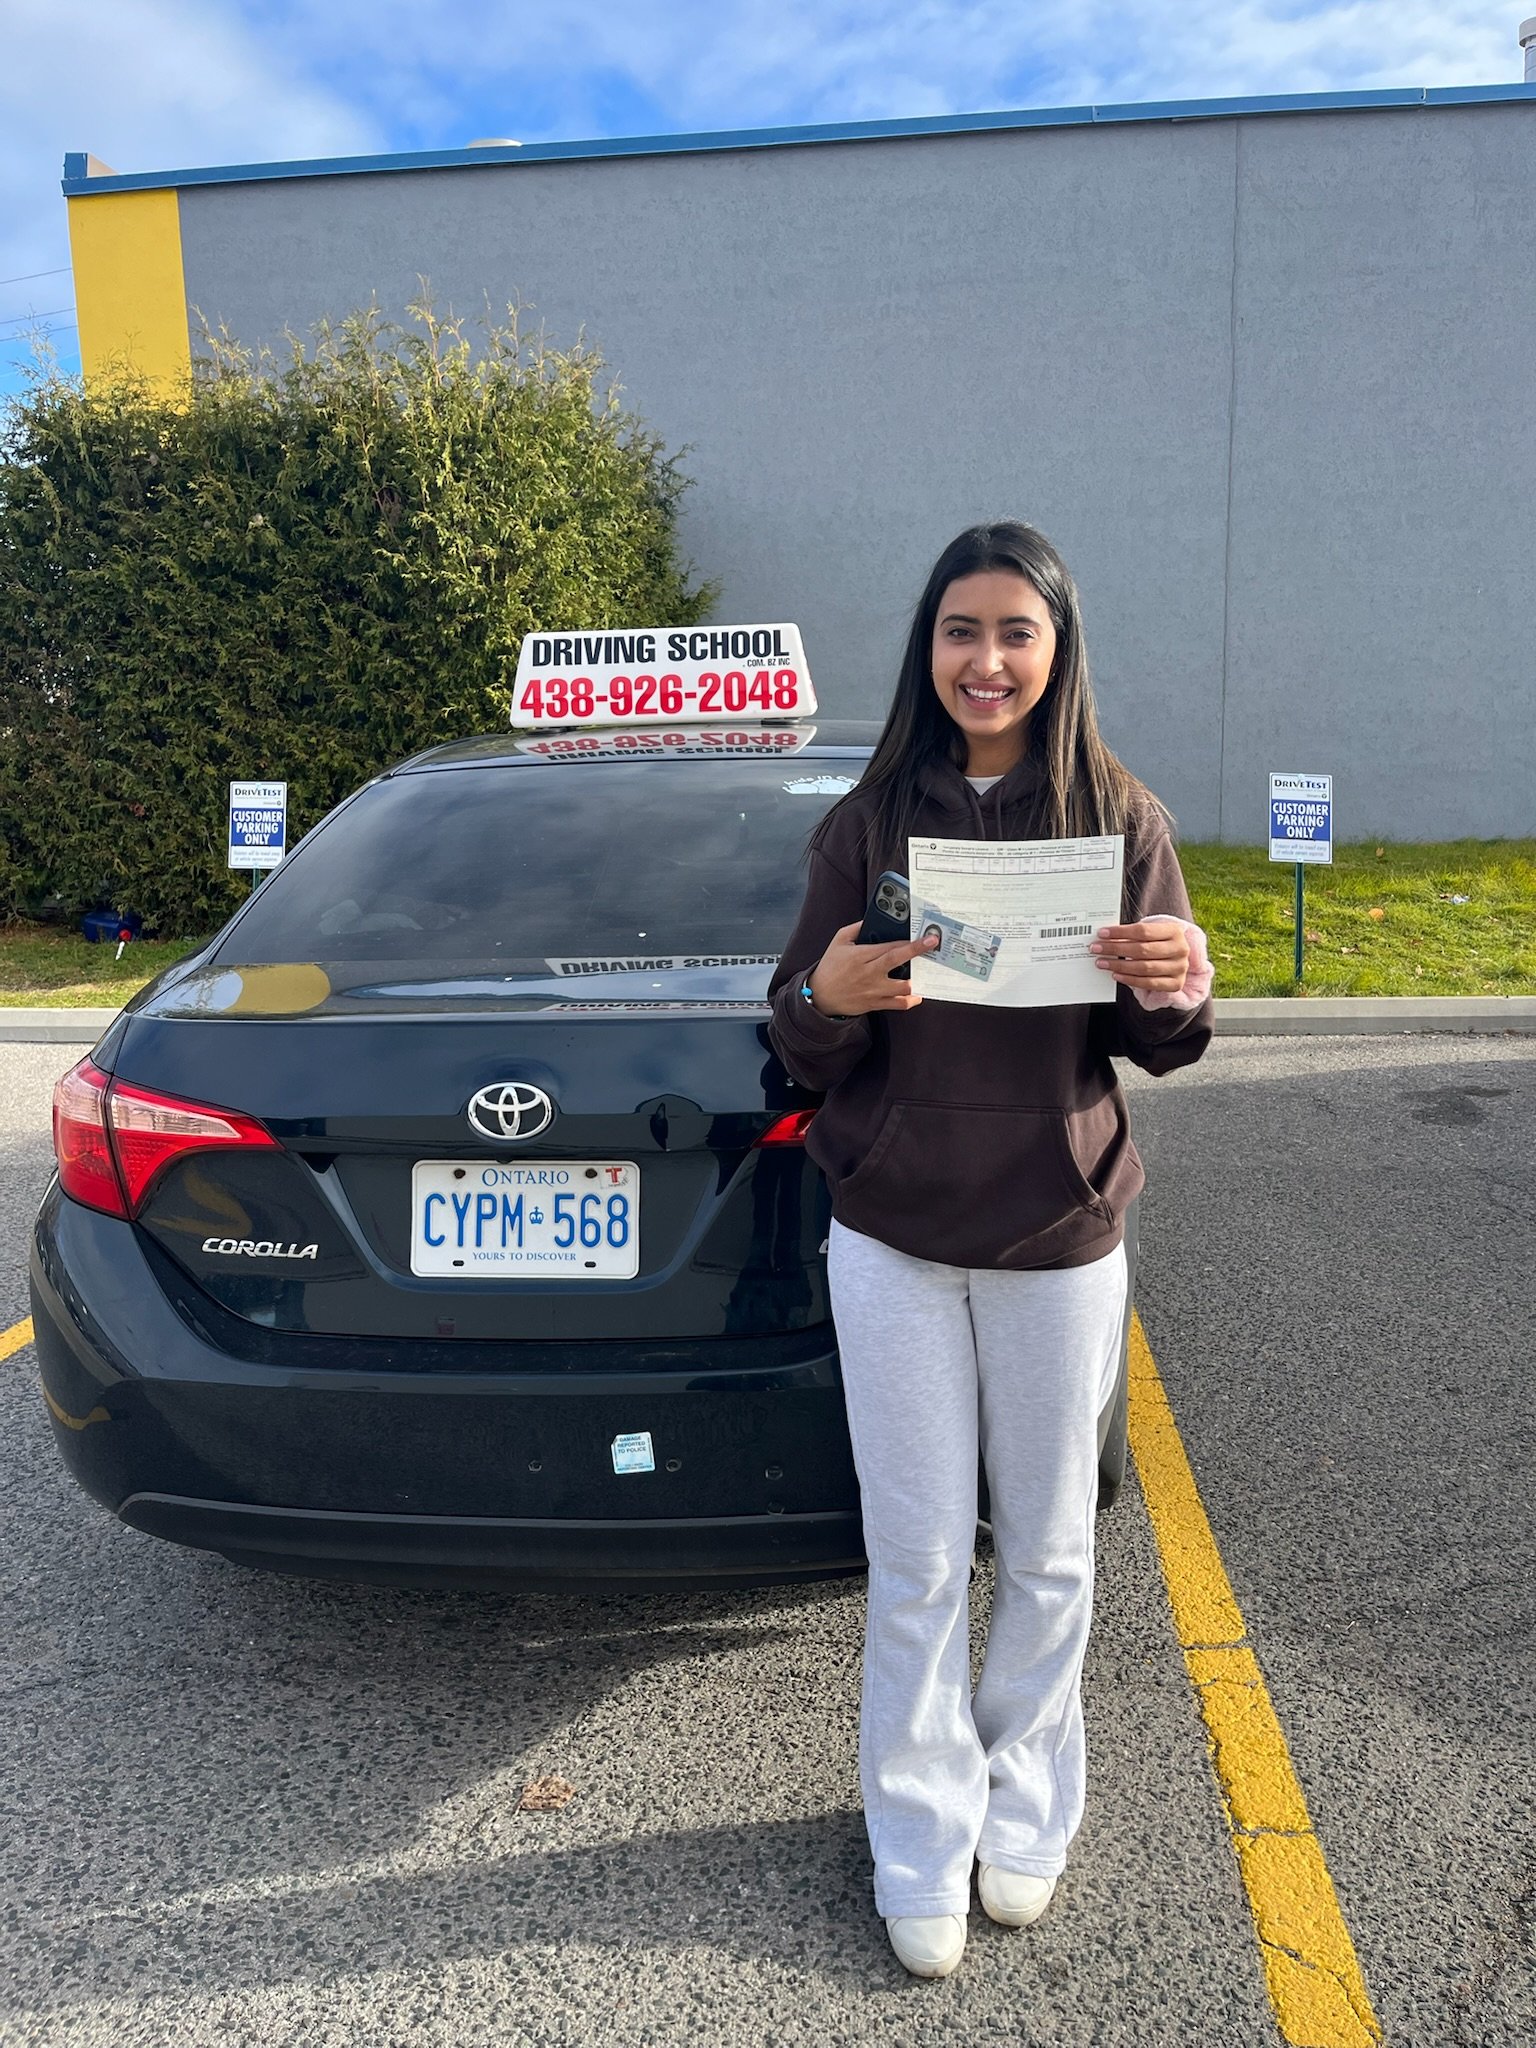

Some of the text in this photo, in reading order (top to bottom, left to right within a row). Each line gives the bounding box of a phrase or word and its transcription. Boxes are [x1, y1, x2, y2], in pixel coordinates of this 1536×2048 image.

[532, 629, 790, 667] DRIVING SCHOOL
[768, 658, 776, 666] BZ
[778, 657, 791, 666] INC
[520, 669, 798, 718] 438-926-2048
[1273, 802, 1328, 816] CUSTOMER
[233, 811, 282, 822] CUSTOMER
[1277, 814, 1324, 827] PARKING
[236, 822, 279, 834] PARKING
[1286, 826, 1315, 838] ONLY
[244, 834, 270, 845] ONLY
[481, 1168, 570, 1187] ONTARIO
[424, 1193, 629, 1247] CYPM 568
[202, 1238, 318, 1260] COROLLA
[473, 1252, 576, 1261] YOURS TO DISCOVER
